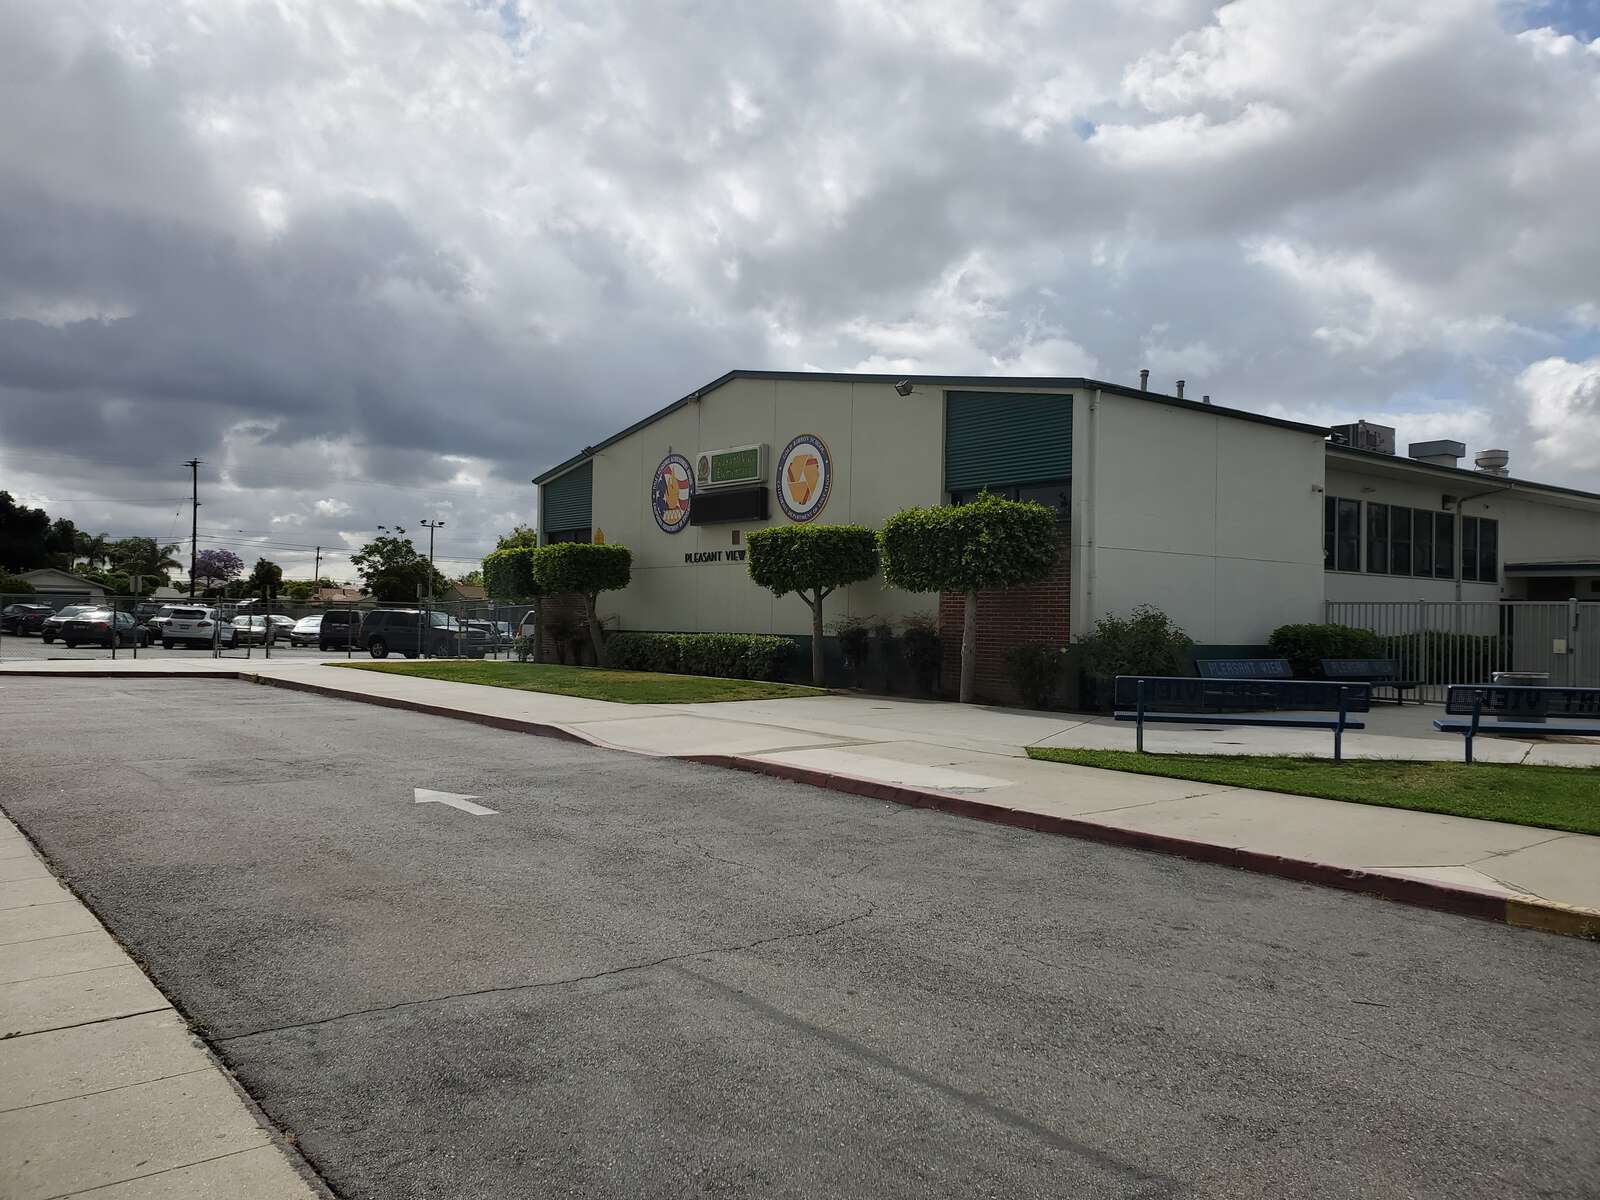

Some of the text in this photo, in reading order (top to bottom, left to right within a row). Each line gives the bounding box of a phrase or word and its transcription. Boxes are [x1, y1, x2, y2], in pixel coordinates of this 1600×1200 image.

[685, 550, 746, 563] PLEASANT VIEW
[1207, 662, 1255, 675] PLEASANT
